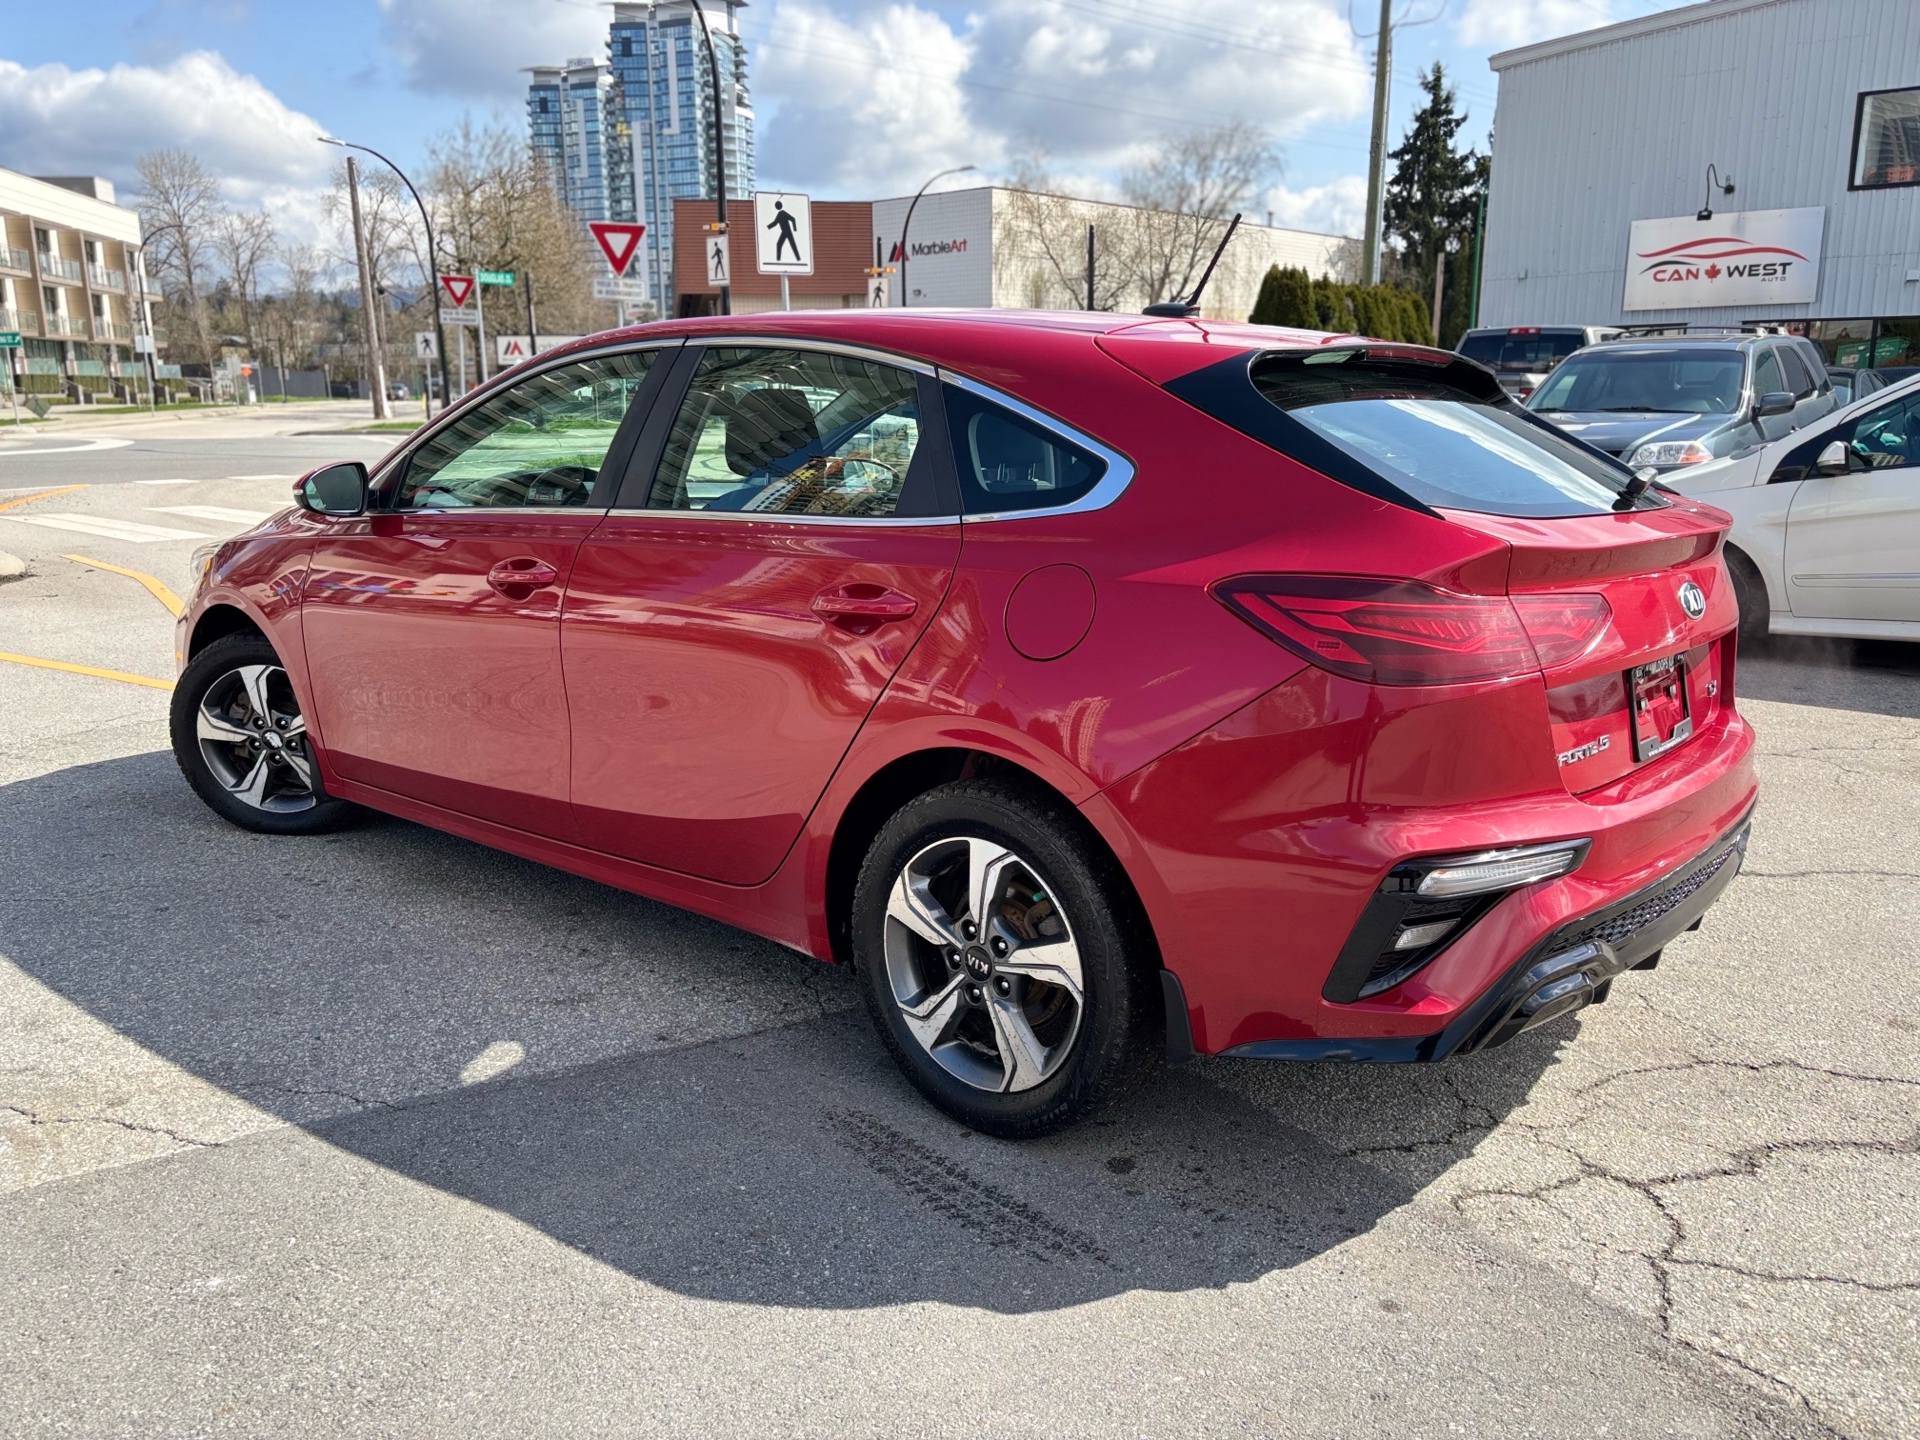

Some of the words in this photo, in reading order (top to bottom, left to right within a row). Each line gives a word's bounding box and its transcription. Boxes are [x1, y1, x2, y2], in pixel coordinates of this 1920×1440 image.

[912, 239, 967, 256] MarbleArt
[1653, 267, 1700, 282] CAN
[1726, 262, 1793, 278] WEST
[1685, 588, 1704, 612] KIA
[967, 953, 989, 975] KIA
